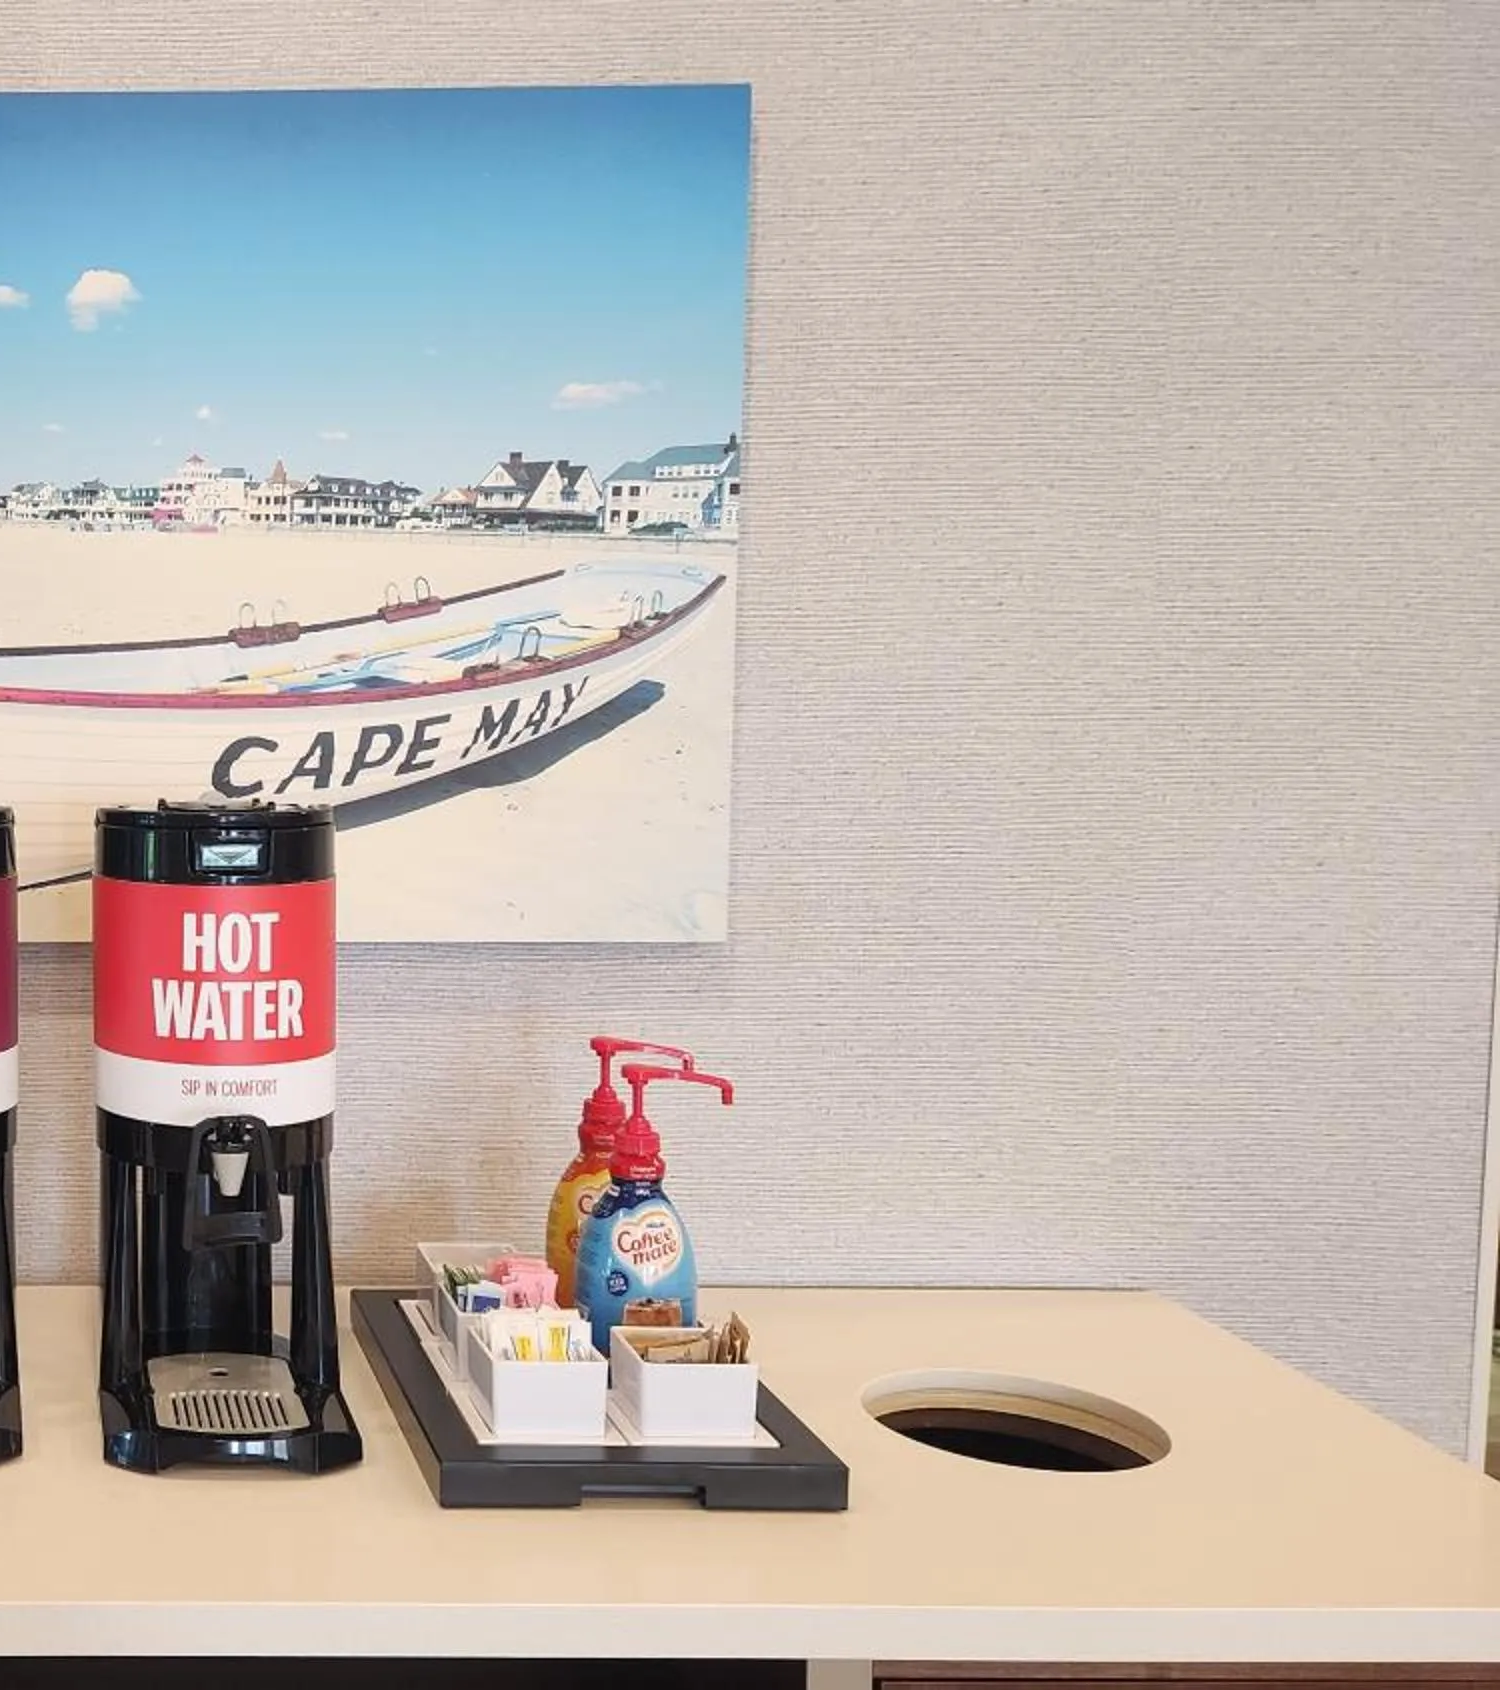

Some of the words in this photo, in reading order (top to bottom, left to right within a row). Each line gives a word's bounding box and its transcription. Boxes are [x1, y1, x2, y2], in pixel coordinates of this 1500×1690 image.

[210, 713, 453, 799] CAPE
[460, 675, 590, 760] MAY
[182, 912, 280, 974] HOT
[151, 978, 304, 1042] WATER
[181, 1079, 201, 1096] SIP
[205, 1079, 217, 1096] IN
[221, 1079, 278, 1097] COMFORT
[617, 1227, 674, 1253] Coffee
[632, 1240, 678, 1265] mate
